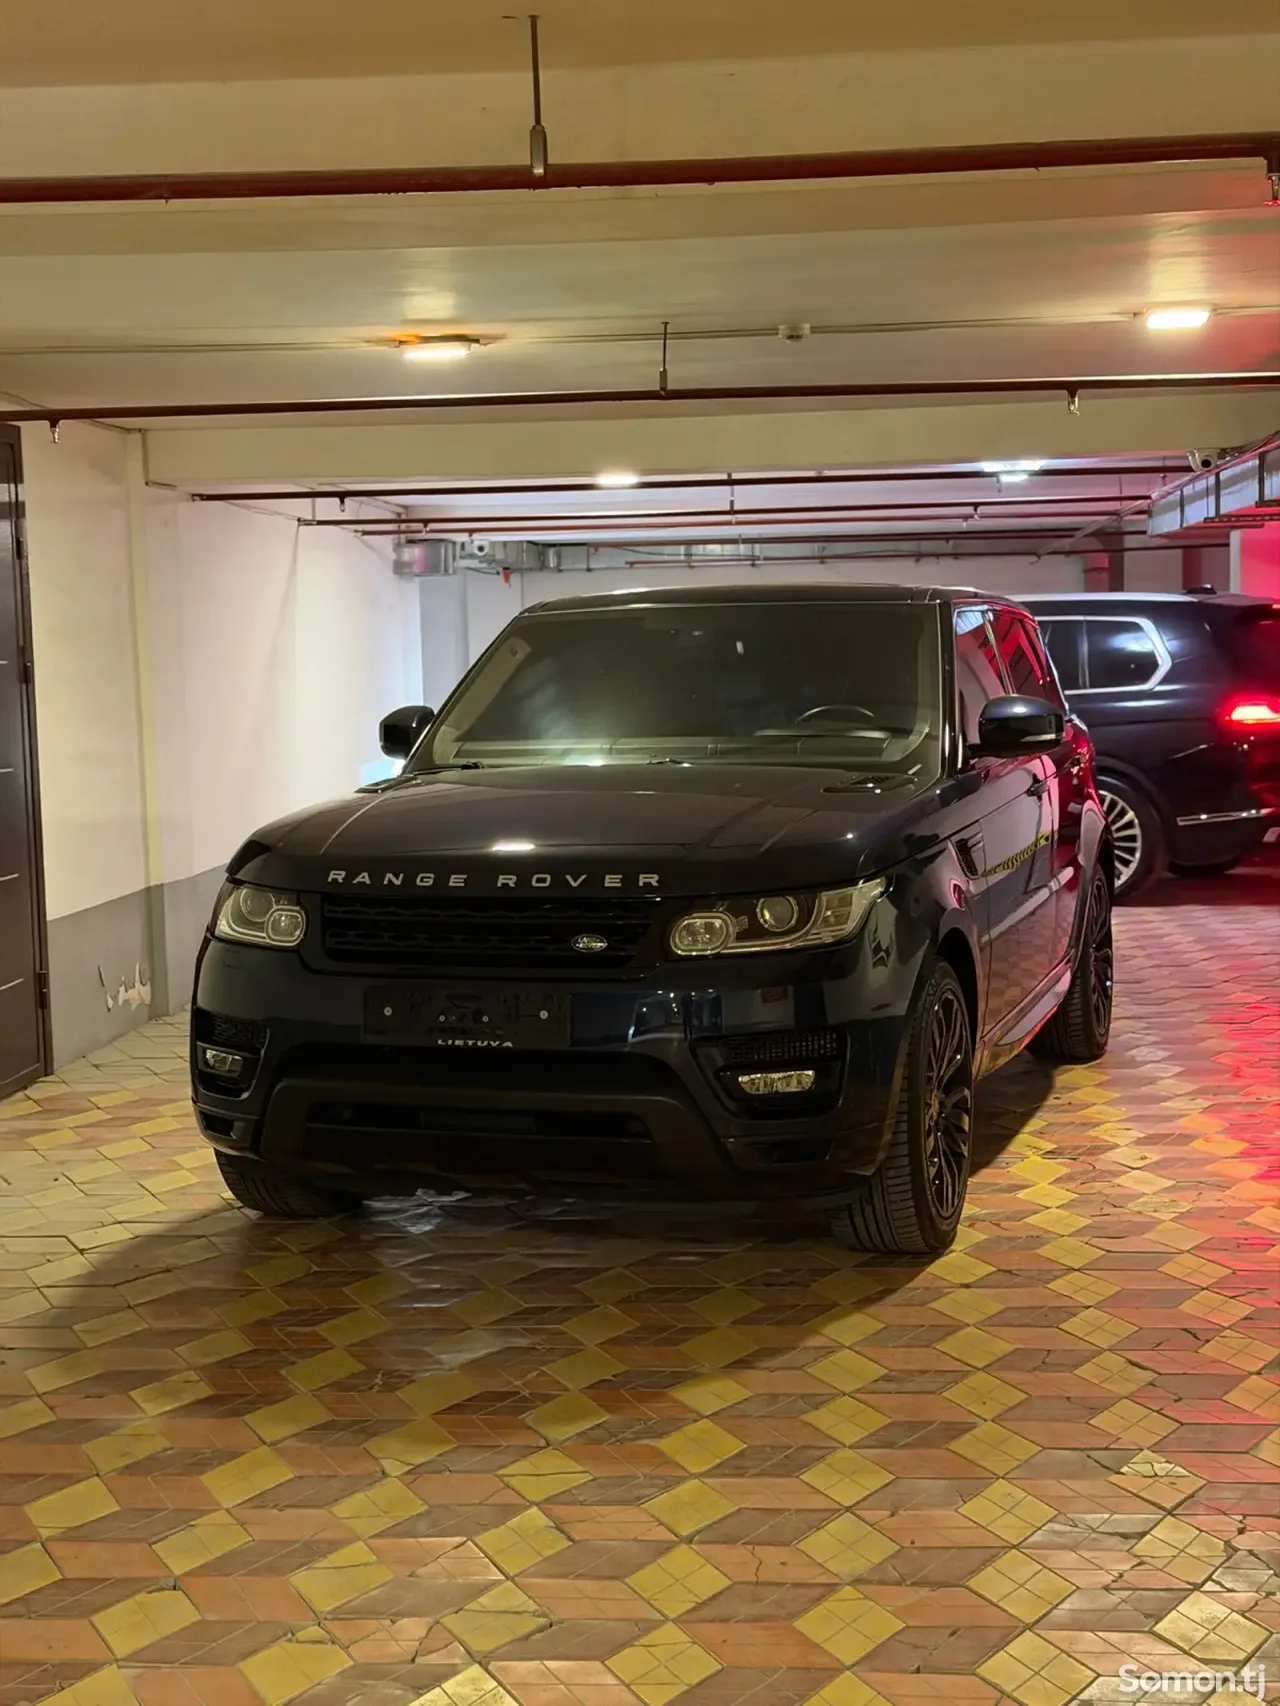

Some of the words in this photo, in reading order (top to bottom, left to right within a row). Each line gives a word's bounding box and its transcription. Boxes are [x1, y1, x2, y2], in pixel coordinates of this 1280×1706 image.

[327, 870, 468, 888] RANGE
[496, 873, 660, 888] ROVER
[437, 1039, 514, 1048] LIETUVA
